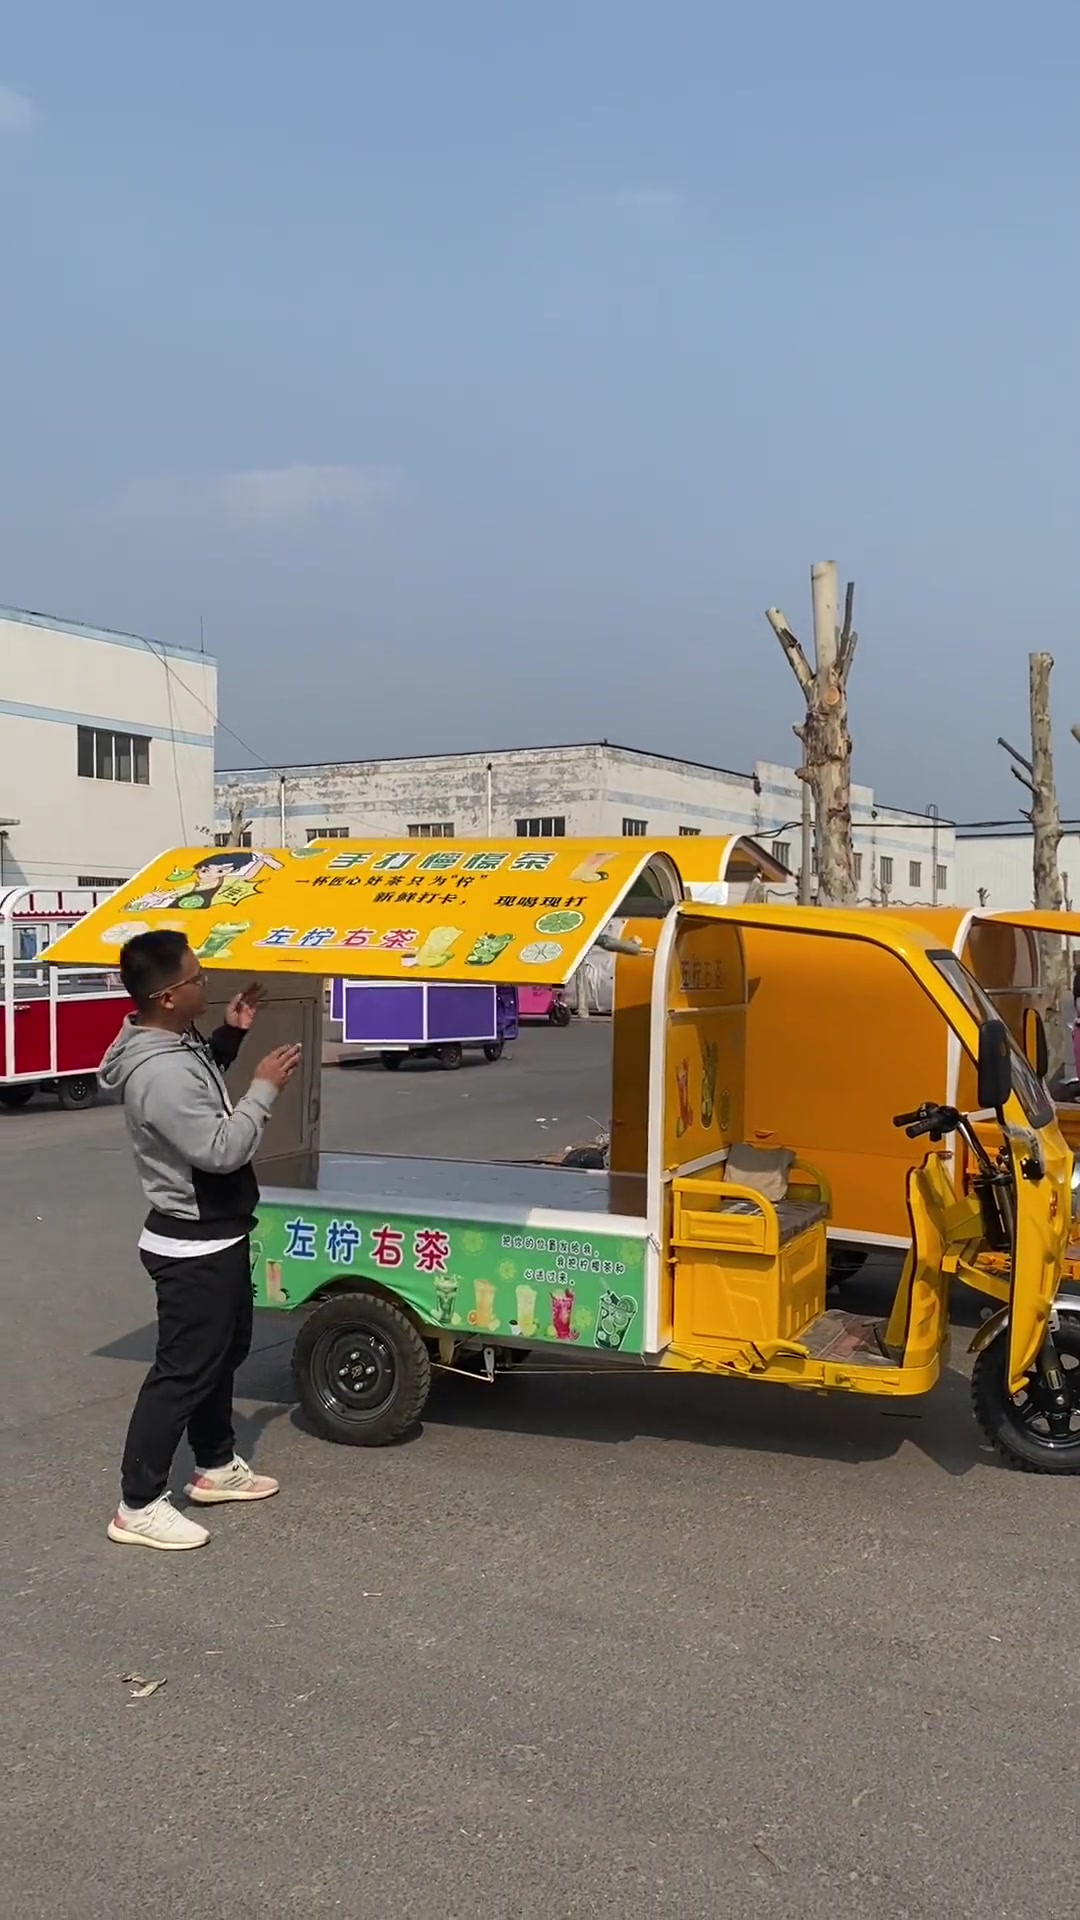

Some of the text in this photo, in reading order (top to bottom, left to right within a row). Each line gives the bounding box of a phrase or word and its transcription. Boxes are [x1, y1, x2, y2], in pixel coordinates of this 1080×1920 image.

[494, 896, 588, 907] 现喝现打
[261, 926, 419, 949] 左柠右茶
[283, 1216, 452, 1273] 左柠右茶
